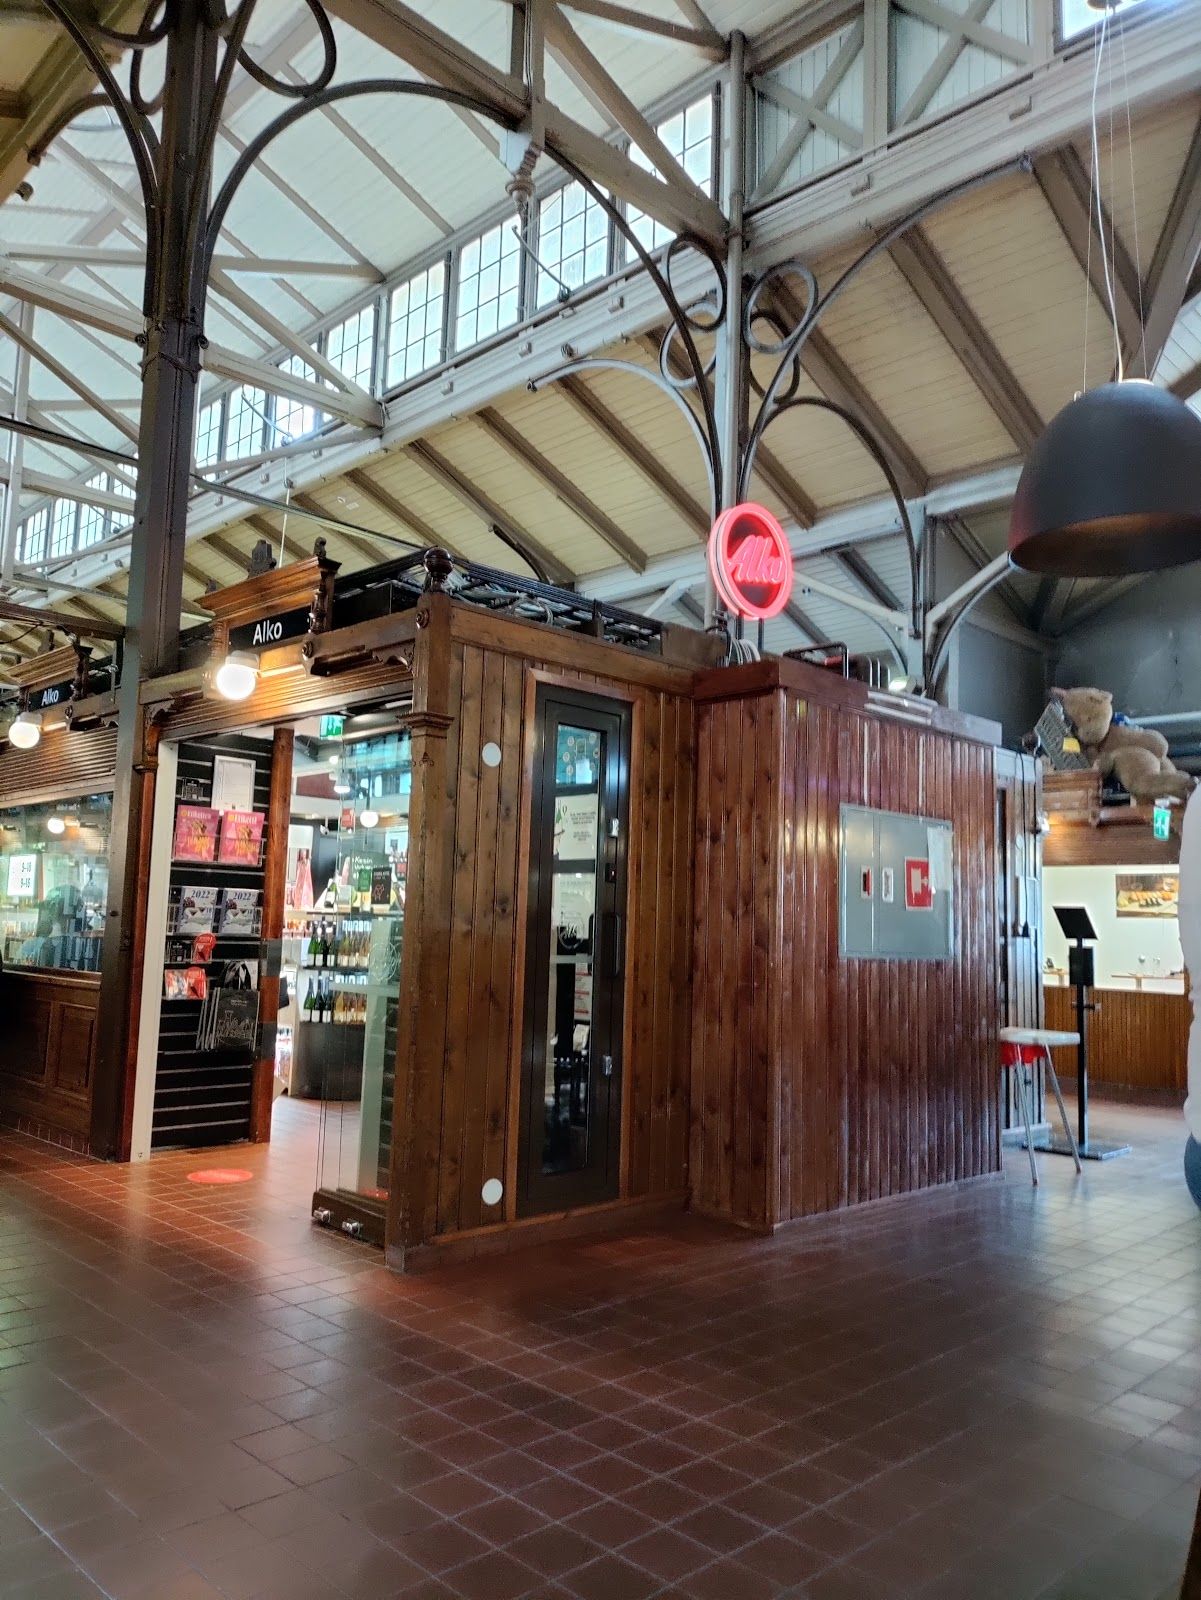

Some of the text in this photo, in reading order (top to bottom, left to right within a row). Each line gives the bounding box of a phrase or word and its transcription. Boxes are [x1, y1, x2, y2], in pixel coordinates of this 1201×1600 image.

[727, 534, 785, 584] Alko
[252, 619, 283, 645] Alko
[41, 688, 60, 706] Alko
[191, 889, 210, 899] 2022
[233, 891, 252, 900] 2022
